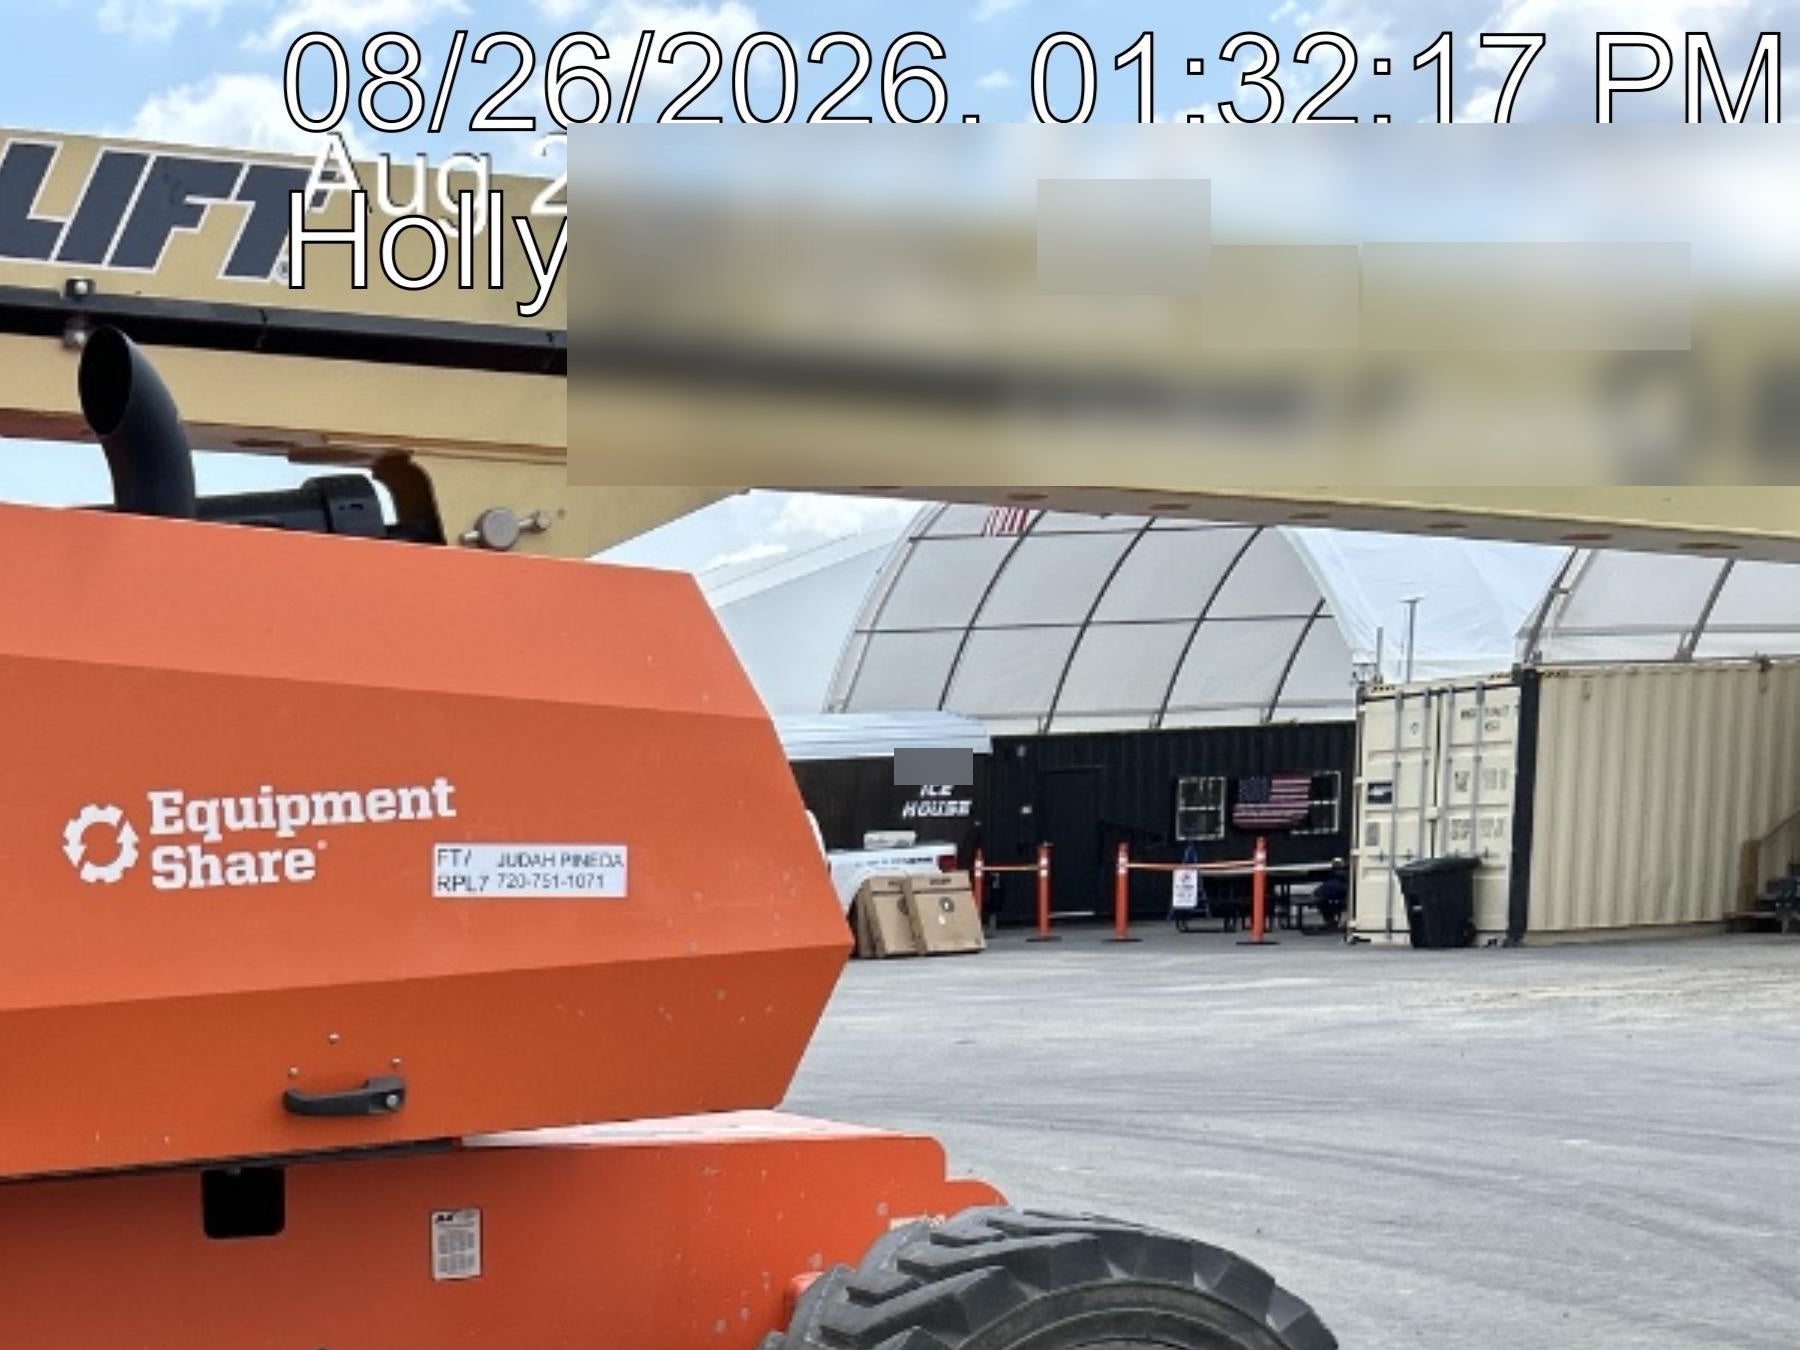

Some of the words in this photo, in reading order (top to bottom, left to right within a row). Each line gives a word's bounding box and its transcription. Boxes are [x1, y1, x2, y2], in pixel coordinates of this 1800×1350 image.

[146, 776, 458, 843] Equipment
[151, 842, 318, 890] Share
[496, 851, 556, 868] JUDAH
[560, 851, 626, 868] PINEDA
